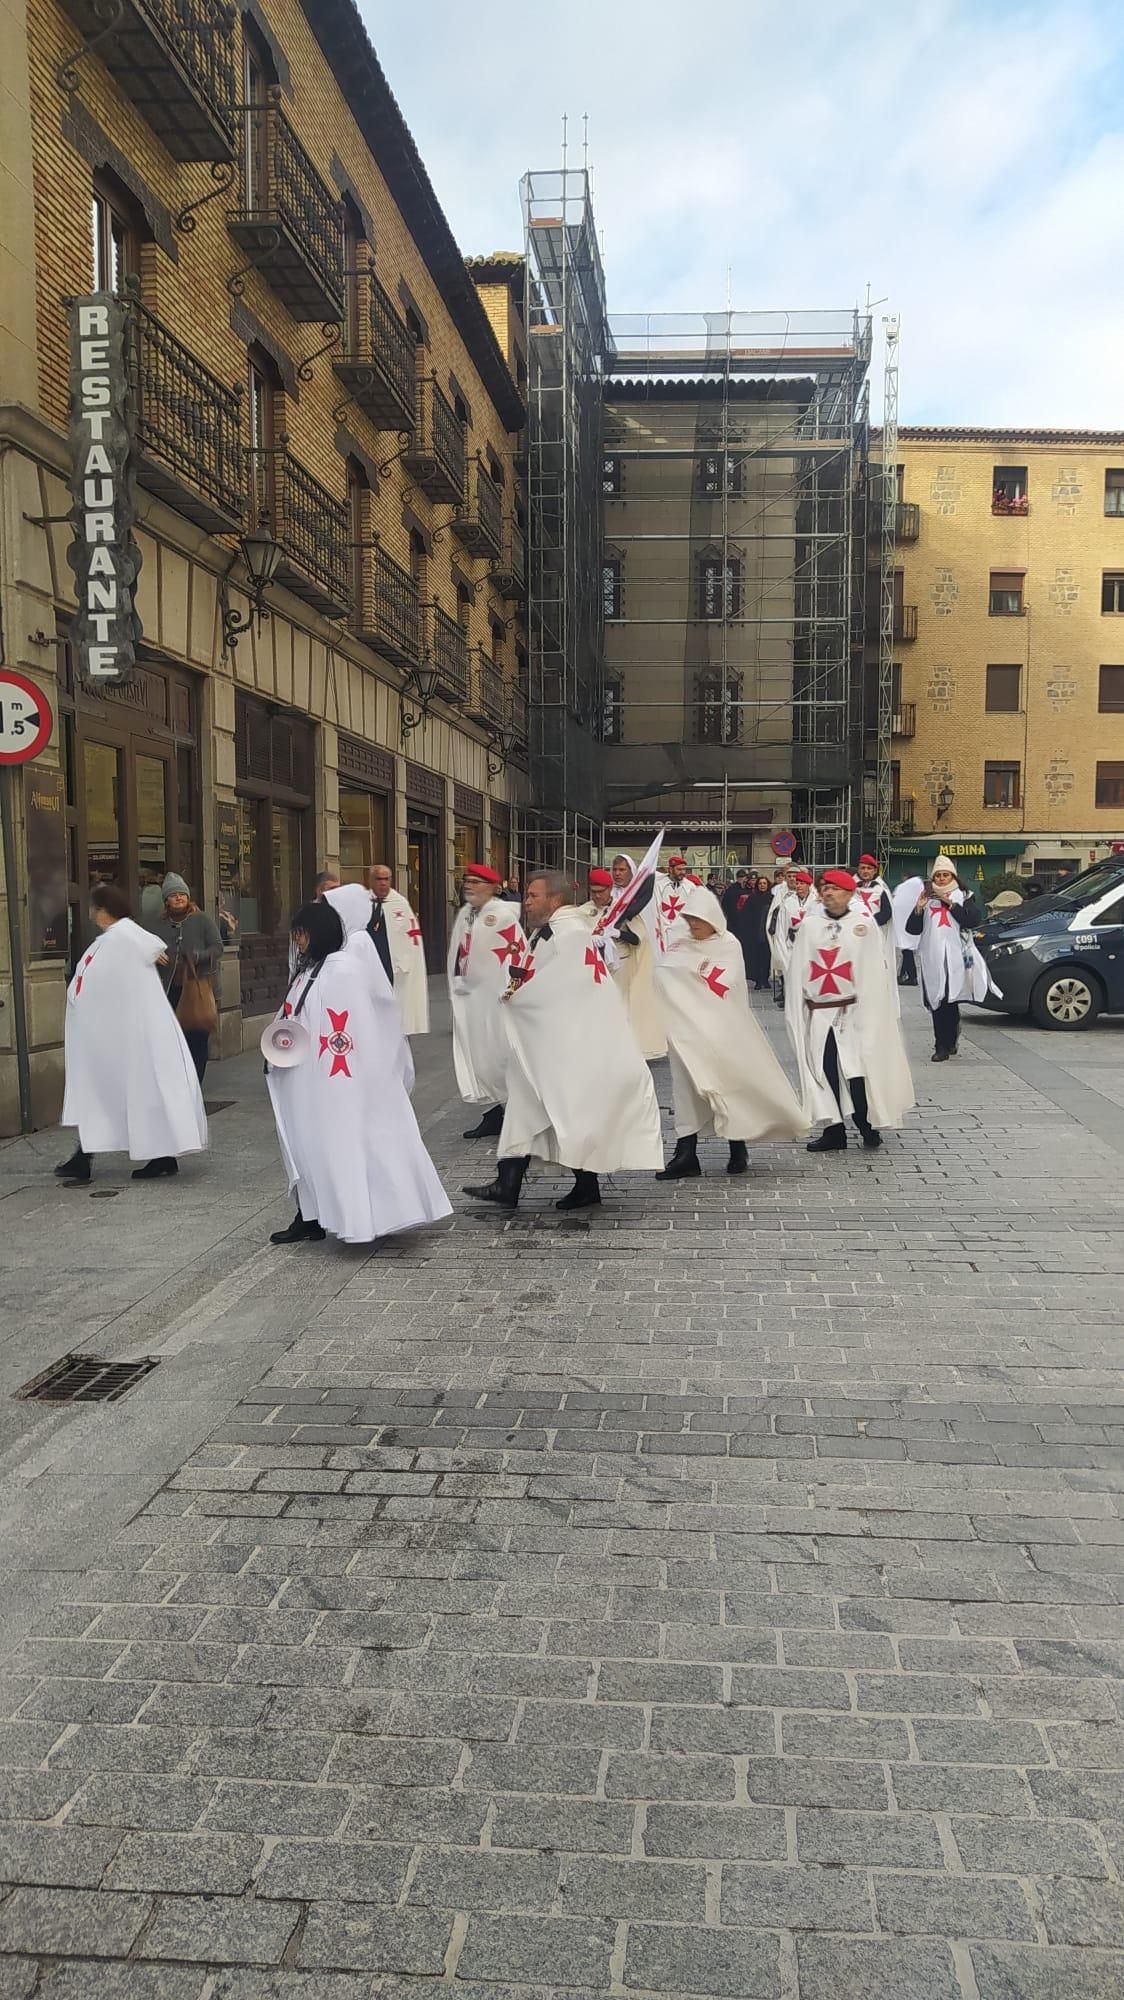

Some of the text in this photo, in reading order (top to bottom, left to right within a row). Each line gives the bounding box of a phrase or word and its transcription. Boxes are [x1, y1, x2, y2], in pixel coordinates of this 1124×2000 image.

[78, 305, 119, 676] RESTAURANTE
[11, 702, 23, 711] m
[608, 820, 673, 832] REGALOS
[939, 844, 987, 856] MEDINA
